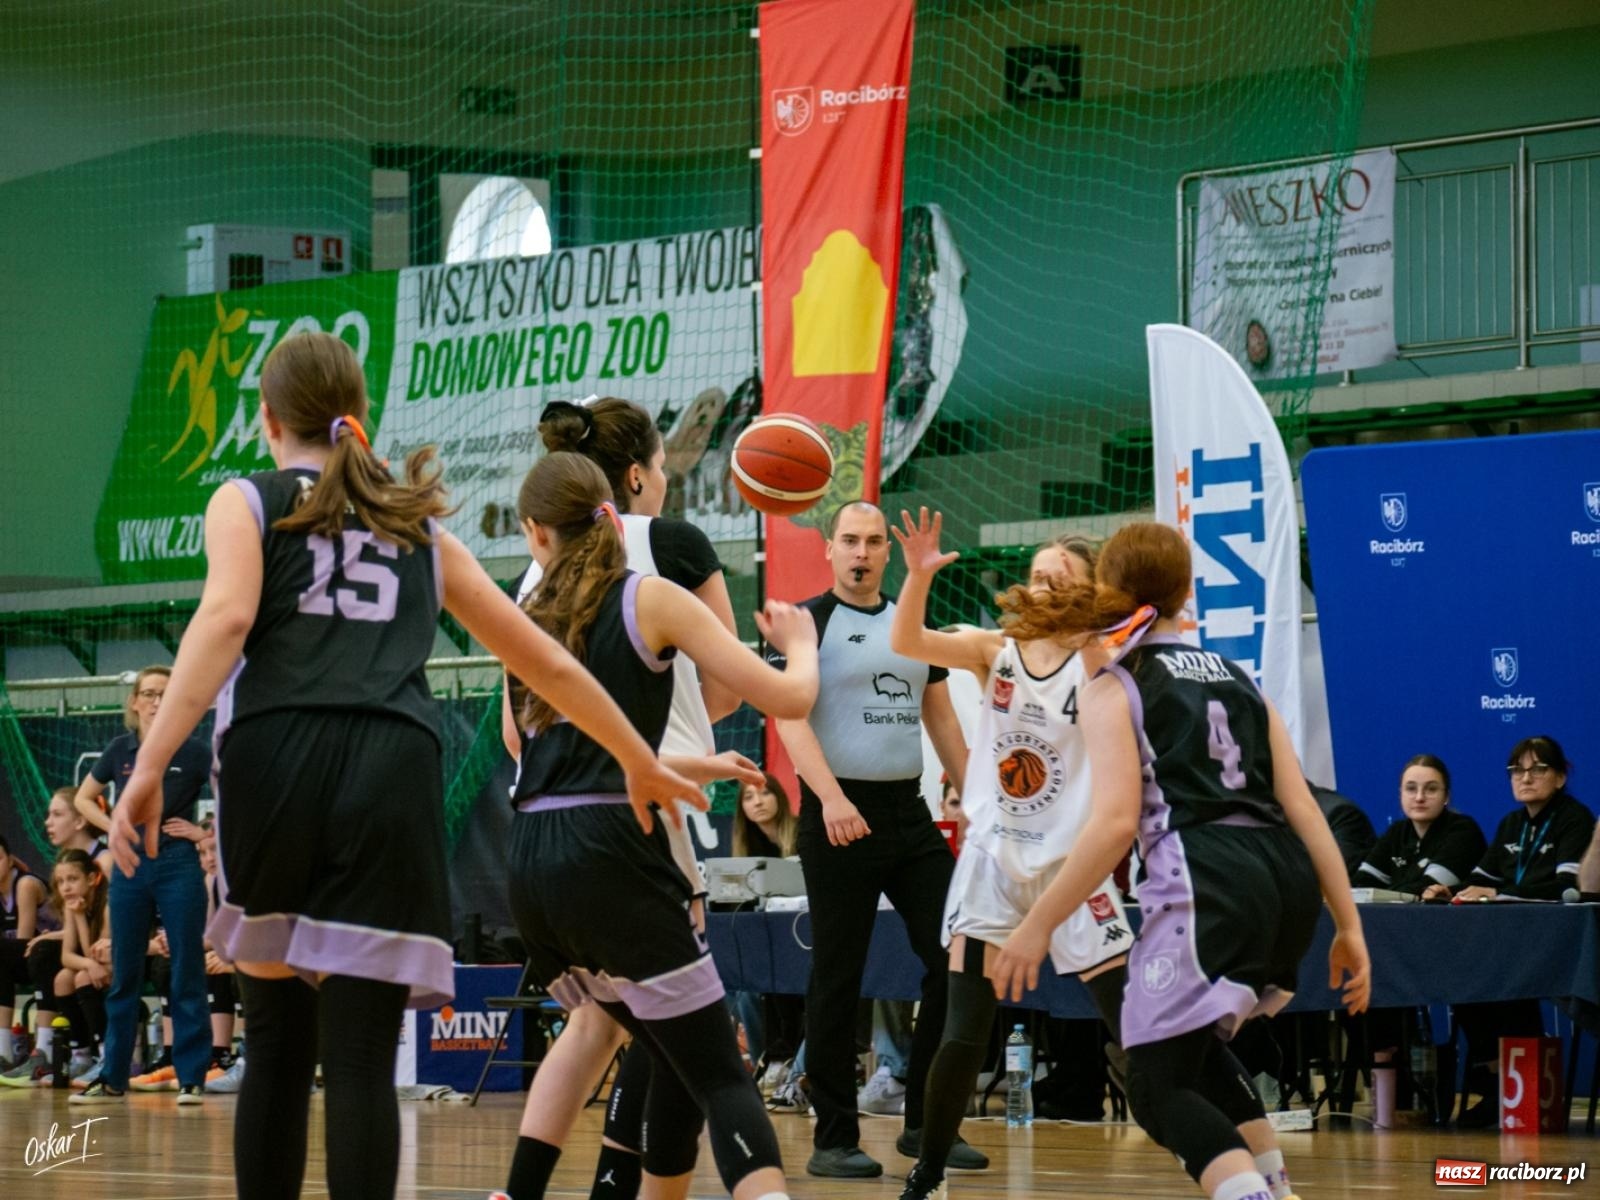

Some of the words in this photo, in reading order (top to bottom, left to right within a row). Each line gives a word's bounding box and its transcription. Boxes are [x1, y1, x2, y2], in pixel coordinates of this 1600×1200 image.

[820, 82, 906, 107] Racibórz
[418, 251, 576, 329] WSZYSTKO
[586, 243, 642, 308] DLA
[655, 225, 764, 299] TWOJE
[407, 322, 593, 400] DOMOWEGO
[600, 311, 670, 379] ZOO
[117, 515, 206, 562] WWW.ZO
[1370, 538, 1425, 554] Racibórz
[1571, 529, 1600, 545] Raci
[298, 530, 399, 622] 15
[848, 634, 867, 644] 4F
[1155, 651, 1229, 673] MINI
[1168, 668, 1235, 683] BASKETBALL
[1062, 685, 1079, 725] 4
[1480, 694, 1535, 710] Racibórz
[863, 712, 895, 724] Bank
[1207, 700, 1247, 790] 4
[430, 1010, 508, 1040] MINI
[431, 1039, 508, 1051] BASKETBAL
[1503, 1047, 1525, 1109] 5
